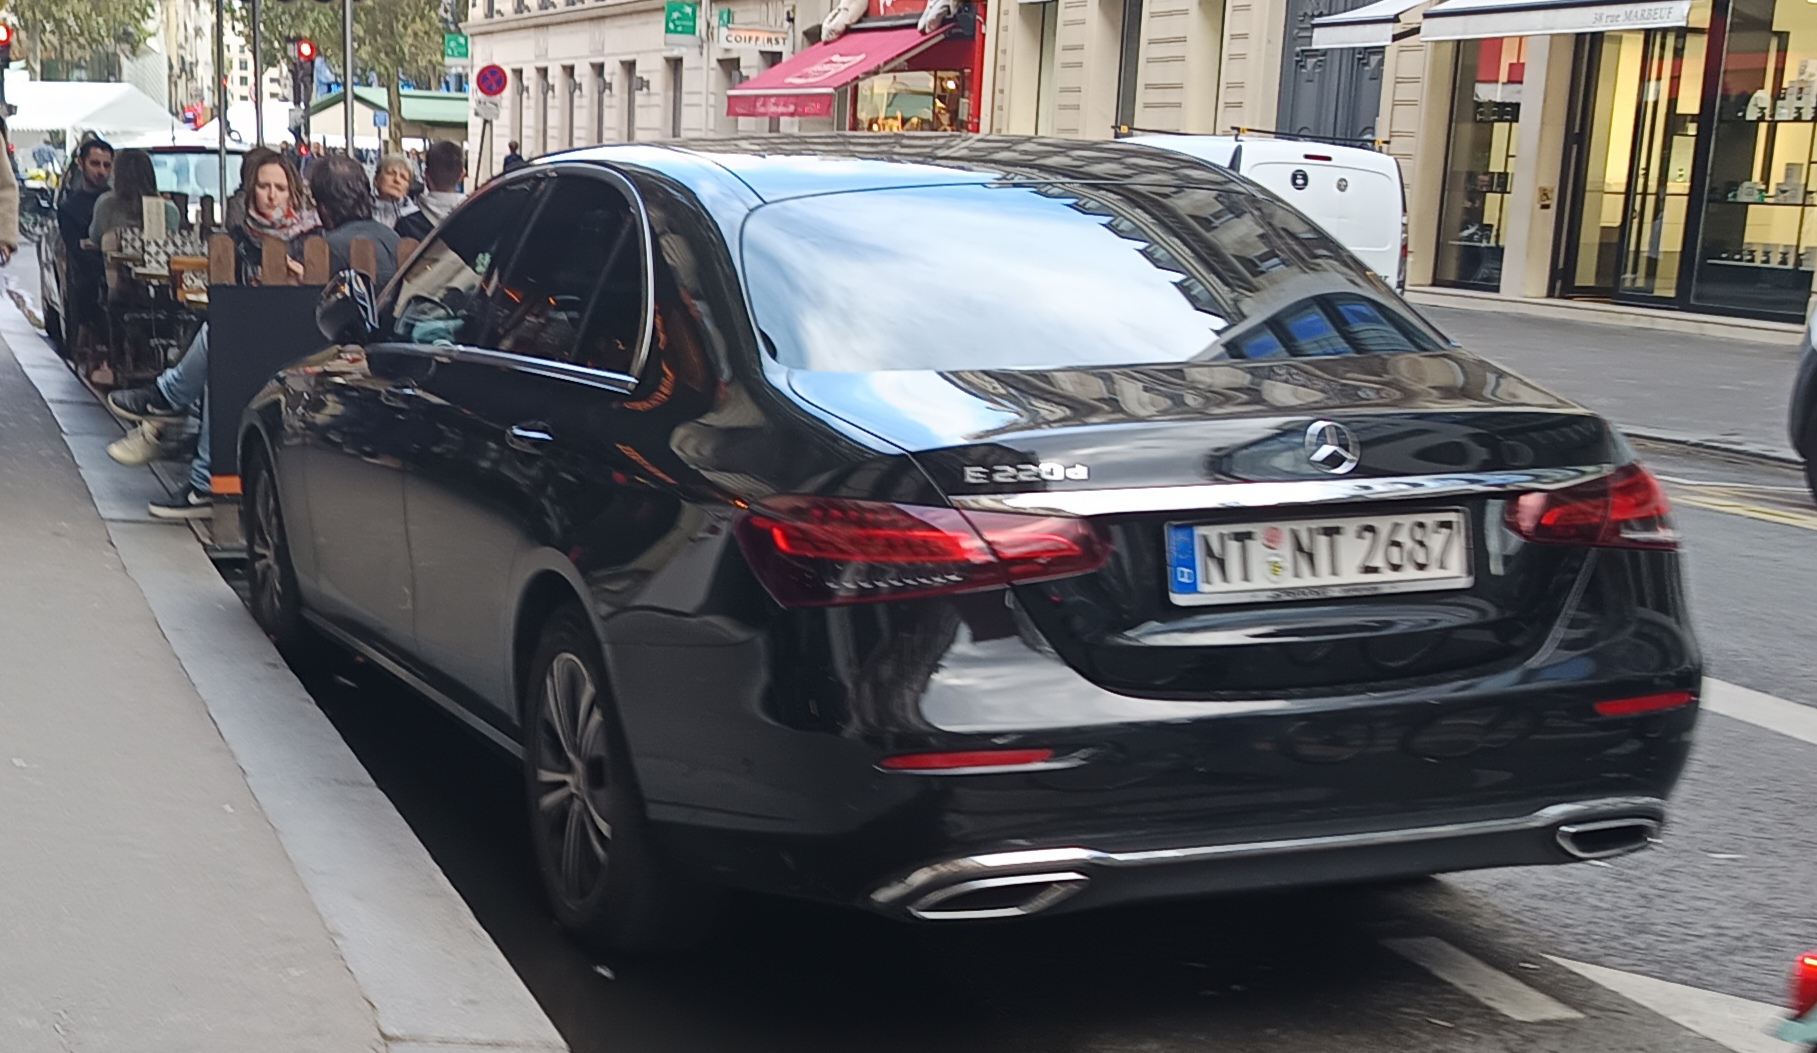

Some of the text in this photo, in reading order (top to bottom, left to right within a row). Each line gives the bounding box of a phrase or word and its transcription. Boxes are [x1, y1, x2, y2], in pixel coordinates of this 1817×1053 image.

[1605, 14, 1621, 23] rue
[1622, 7, 1674, 22] MARBEUF
[725, 34, 788, 47] COIFFIRST
[963, 466, 990, 484] E
[1198, 519, 1456, 585] NT NT 2687
